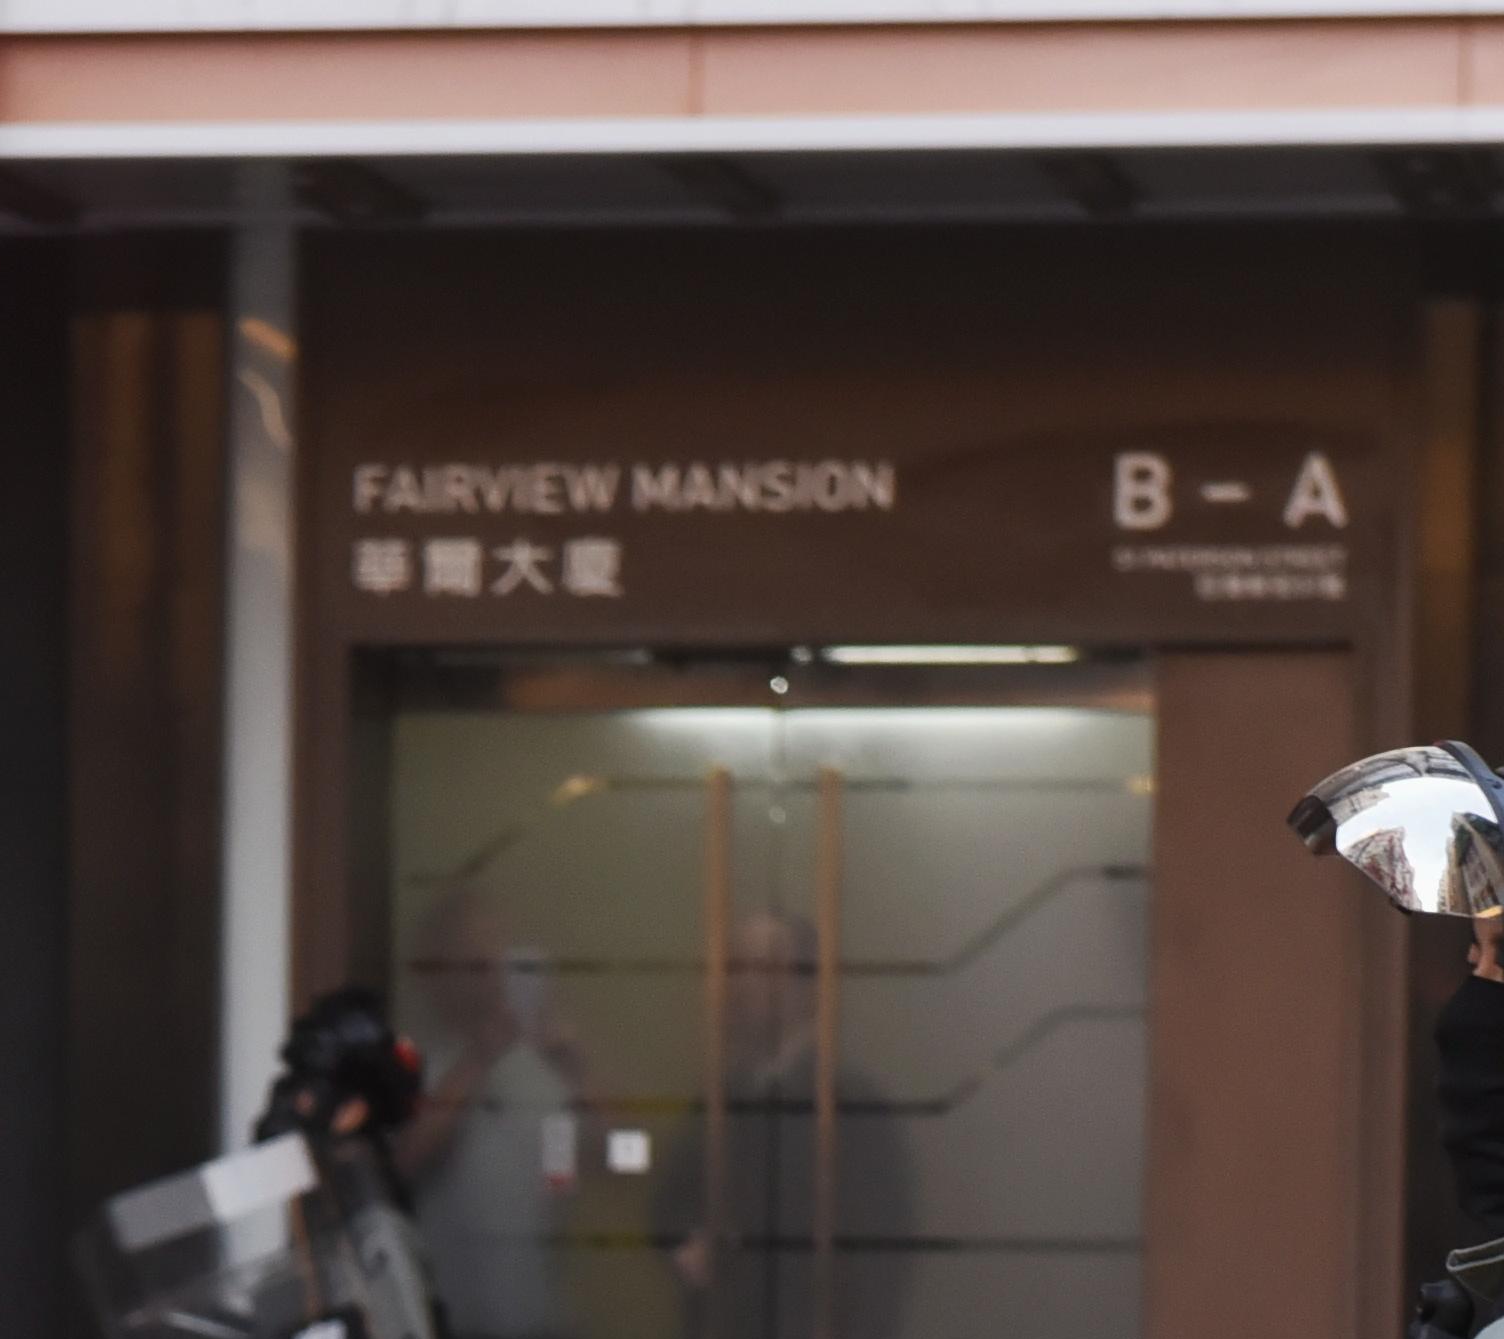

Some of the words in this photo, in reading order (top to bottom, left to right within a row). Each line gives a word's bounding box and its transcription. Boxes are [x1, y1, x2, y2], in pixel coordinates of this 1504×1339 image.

[353, 461, 621, 515] FAIRVIEW
[629, 460, 895, 513] MANSION
[1113, 452, 1173, 531] B
[1282, 450, 1349, 529] A
